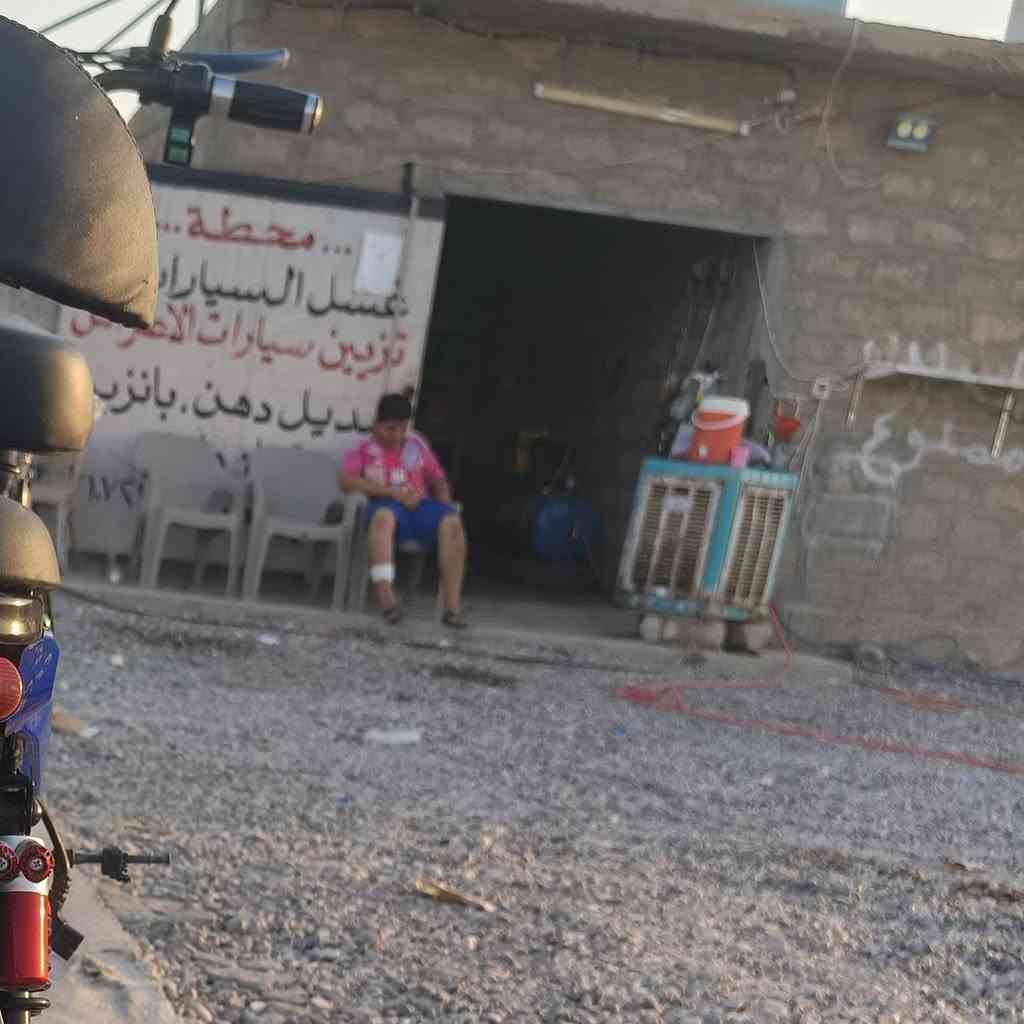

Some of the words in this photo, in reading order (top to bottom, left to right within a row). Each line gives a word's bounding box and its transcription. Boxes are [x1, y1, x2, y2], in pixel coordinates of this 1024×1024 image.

[71, 303, 195, 347] الاعرس
[197, 309, 314, 365] سيارات
[319, 325, 408, 381] تزيين
[93, 366, 176, 421] بانزي
[278, 387, 372, 437] ديل
